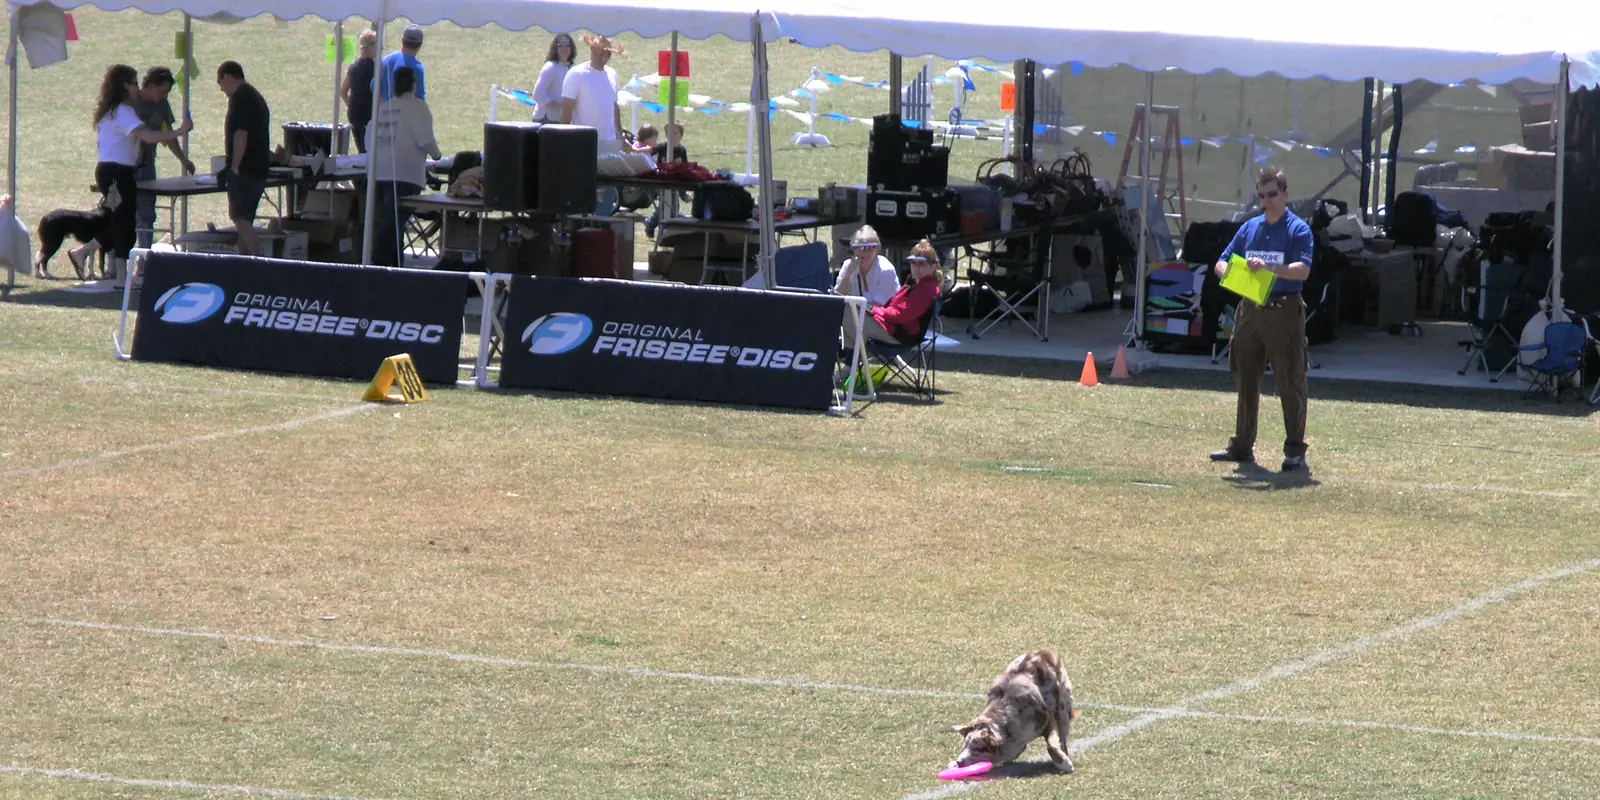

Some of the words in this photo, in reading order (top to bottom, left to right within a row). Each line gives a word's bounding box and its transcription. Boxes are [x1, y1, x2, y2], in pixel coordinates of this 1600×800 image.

[234, 292, 333, 313] ORIGINAL
[602, 321, 704, 342] ORIGINAL
[396, 360, 423, 400] 30
